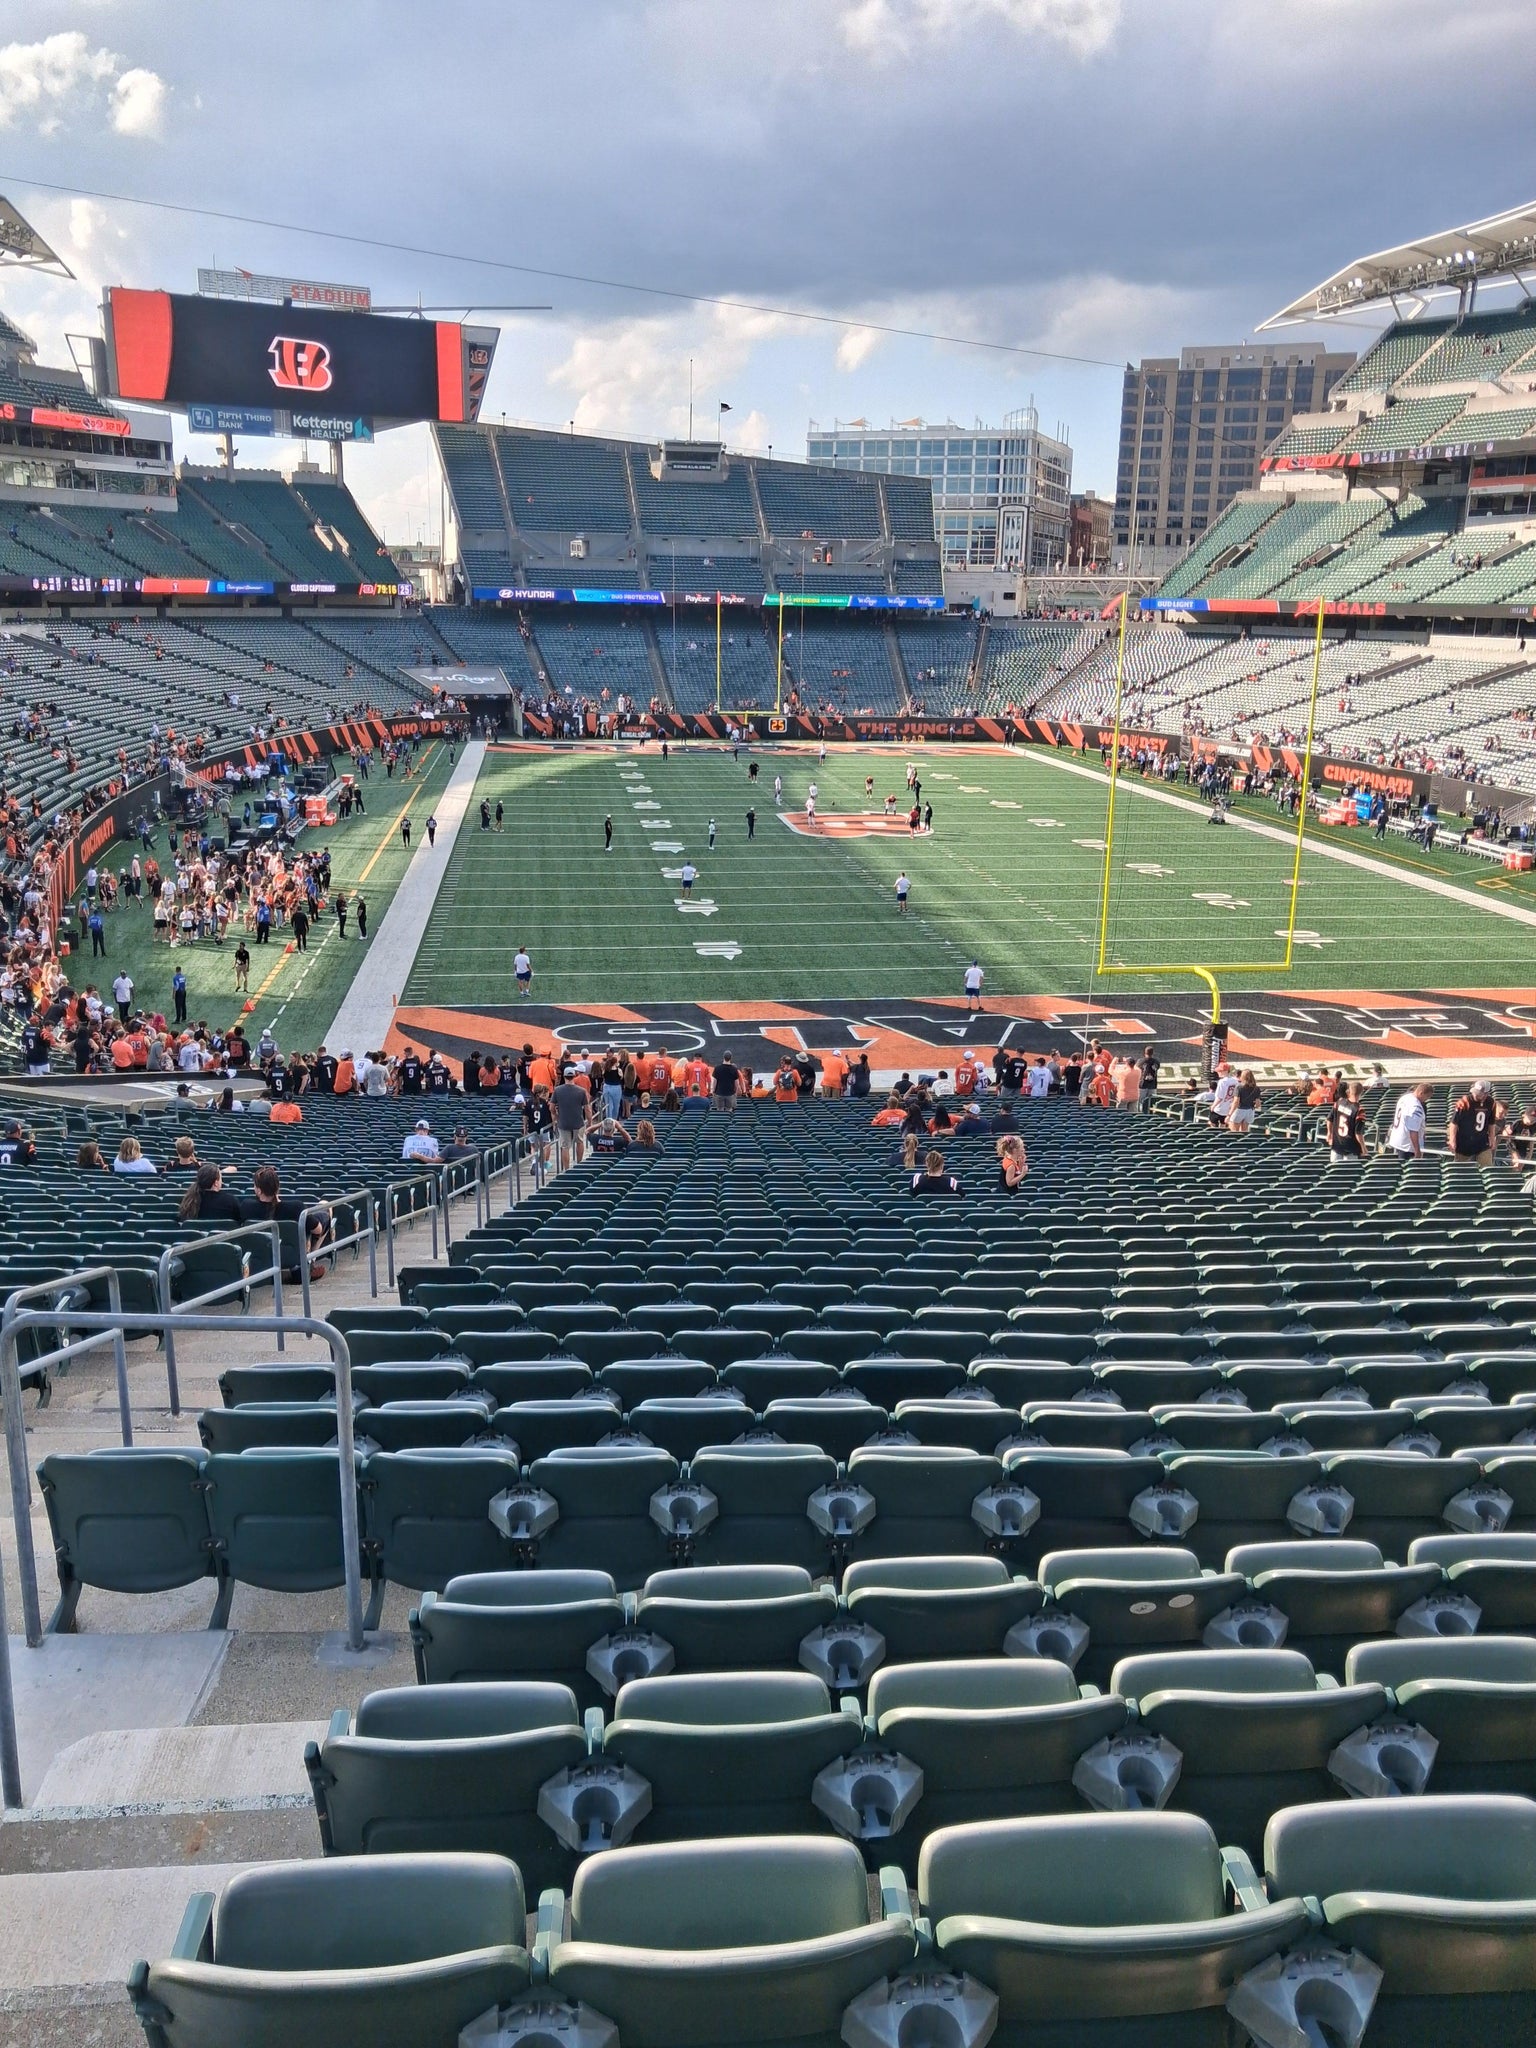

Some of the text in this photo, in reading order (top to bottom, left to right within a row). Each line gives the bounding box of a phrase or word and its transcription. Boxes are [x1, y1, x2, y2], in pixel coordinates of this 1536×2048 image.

[291, 283, 370, 309] STADIUM
[217, 411, 272, 422] FIFTH THIRD
[218, 420, 243, 430] BANK
[293, 415, 353, 433] Kettering
[310, 429, 345, 440] HEALTH
[377, 583, 397, 594] 79:16
[400, 585, 409, 594] 25
[515, 591, 555, 599] HYUNDAI
[685, 594, 711, 604] Paycor
[720, 595, 746, 605] Paycor
[391, 722, 418, 736] WHO
[771, 719, 785, 731] 25
[857, 722, 976, 735] THE JUNGLE
[1139, 735, 1169, 753] DEY
[1323, 764, 1414, 796] CINCINNATI
[552, 1005, 1536, 1055] ENGALS
[28, 1038, 34, 1049] 9
[326, 1066, 332, 1079] 1
[409, 1068, 415, 1078] 9
[654, 1069, 665, 1080] 30
[1014, 1067, 1020, 1078] 9
[959, 1074, 971, 1085] 97
[275, 1079, 283, 1092] 9
[533, 1110, 541, 1124] 9
[1475, 1111, 1486, 1131] 9
[1337, 1114, 1349, 1137] 5
